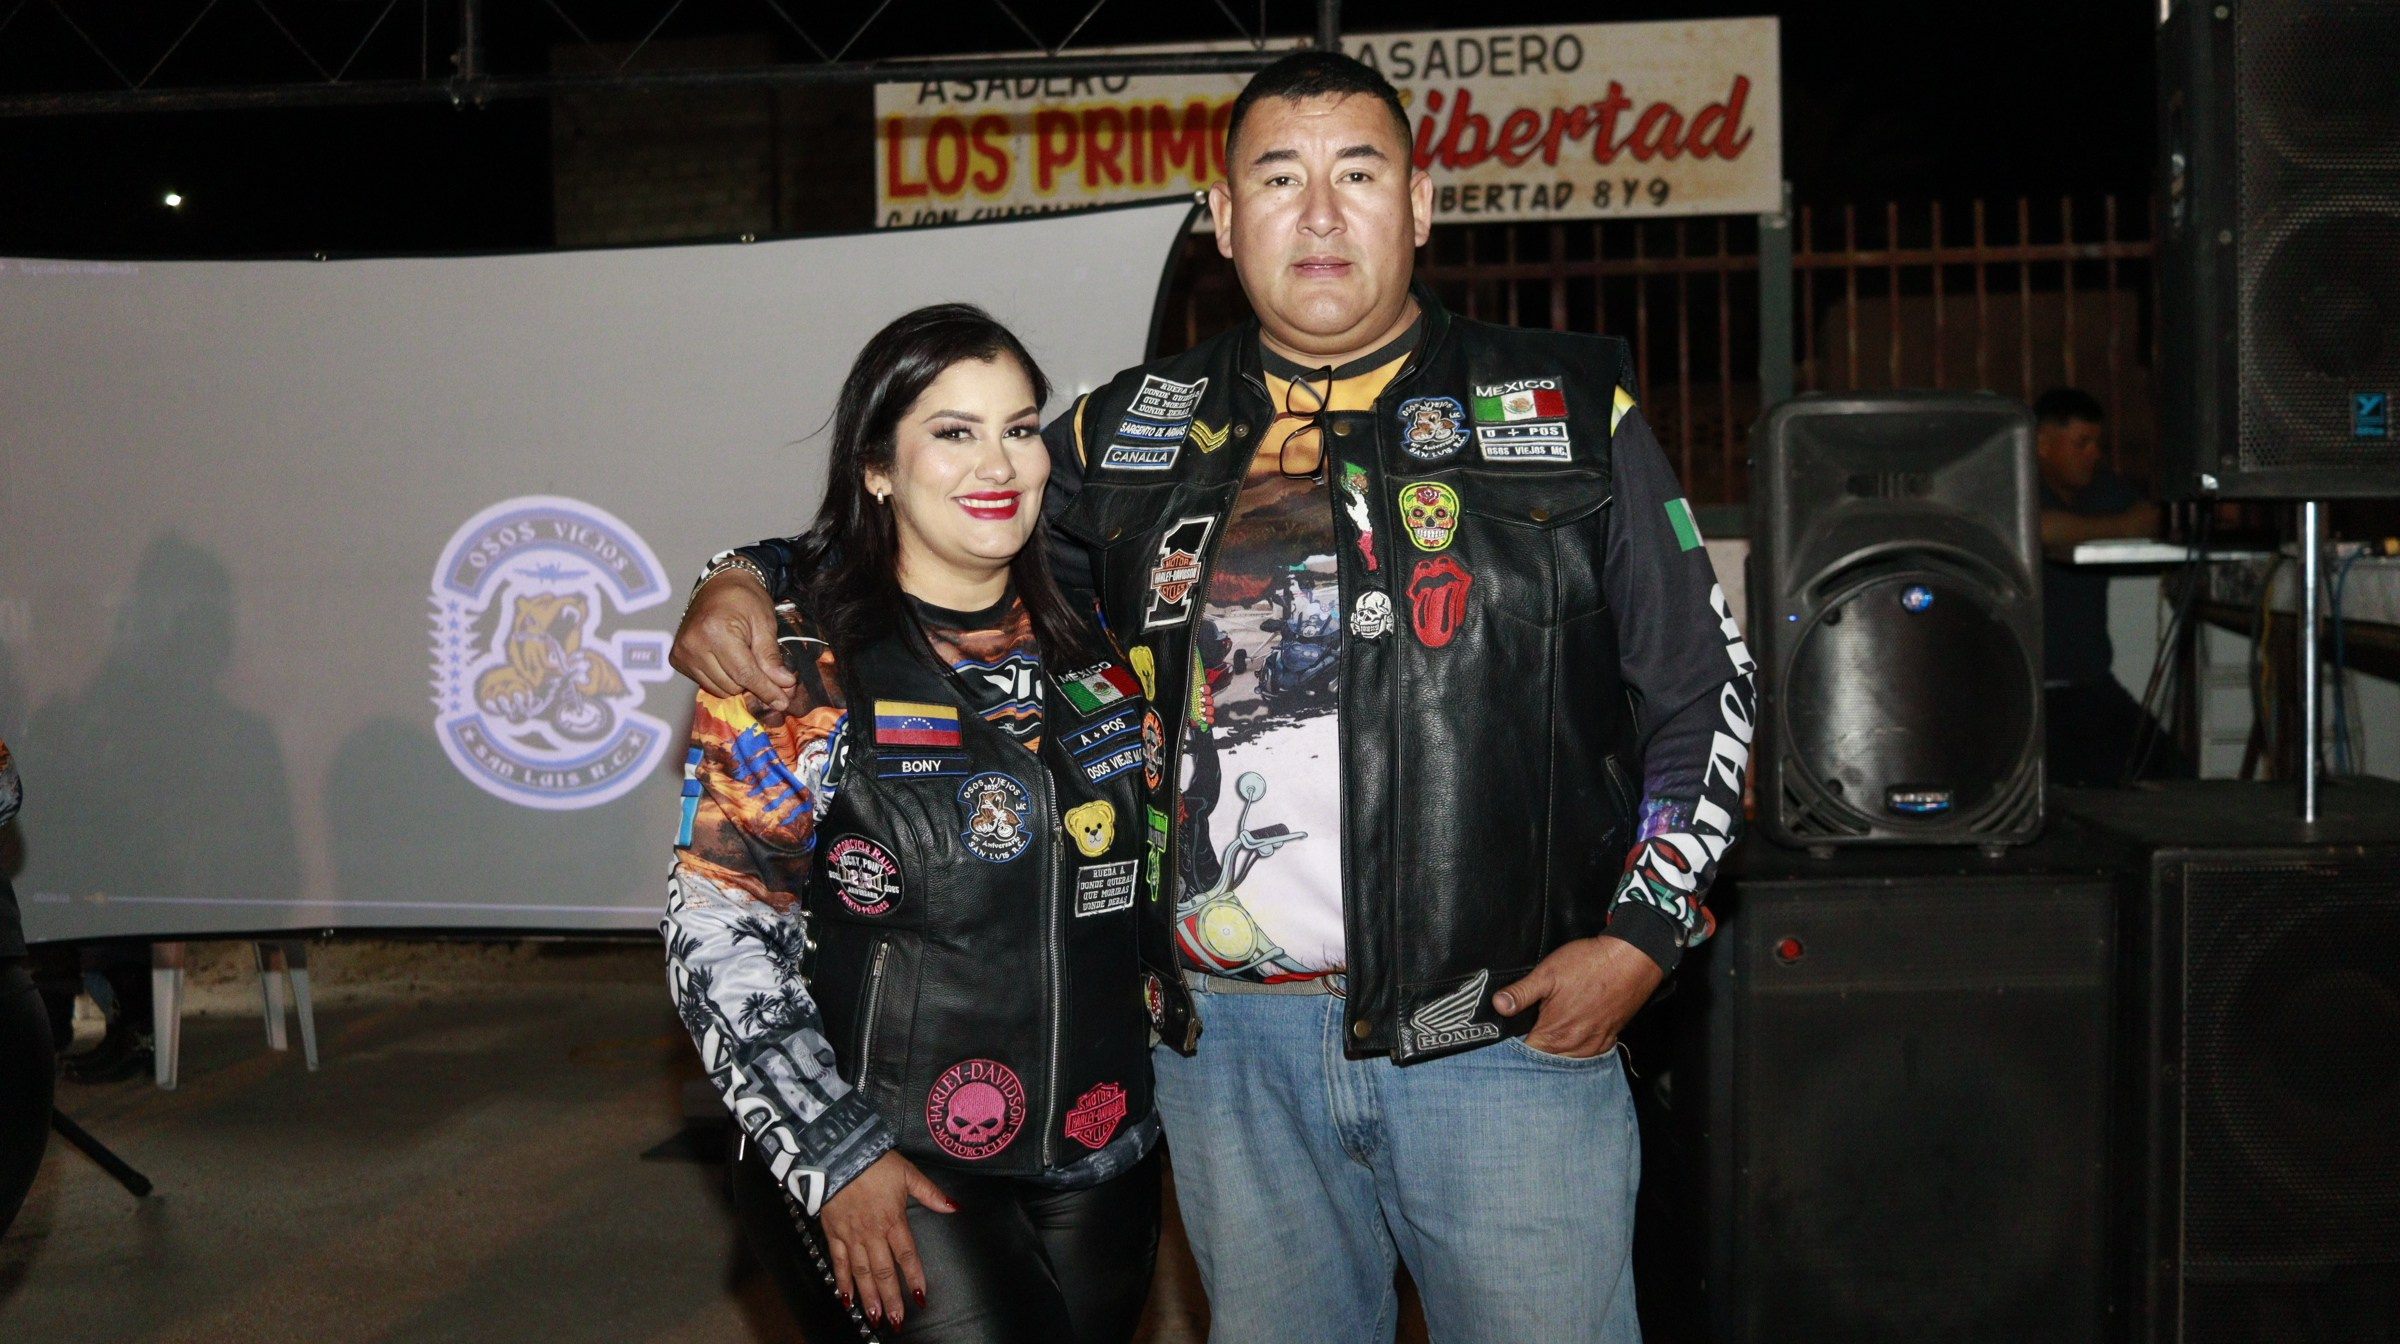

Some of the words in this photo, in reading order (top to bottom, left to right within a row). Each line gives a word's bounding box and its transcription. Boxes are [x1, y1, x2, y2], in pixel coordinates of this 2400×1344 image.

[1356, 34, 1585, 82] ASADERO
[1411, 74, 1754, 171] ibertad
[886, 113, 1012, 199] LOS
[1143, 388, 1170, 399] DONDE
[1475, 380, 1556, 398] MEXICO
[1142, 396, 1161, 406] QUE
[1138, 404, 1166, 416] DONDE
[1528, 426, 1559, 437] POS
[1112, 451, 1168, 463] CANALLA
[1486, 446, 1510, 456] OSOS
[1514, 446, 1546, 456] VIEJOS
[468, 520, 536, 569] OSOS
[1165, 557, 1190, 569] MOTOR
[1161, 584, 1186, 599] CYCLES
[1080, 734, 1092, 746] A
[1101, 717, 1126, 735] POS
[902, 760, 942, 774] BONY
[1087, 760, 1111, 779] OSOS
[963, 779, 985, 799] OSOS
[968, 841, 986, 858] SAN
[871, 847, 897, 876] RALLY
[1093, 868, 1117, 878] RUEDA
[1080, 880, 1104, 890] DONDE
[1083, 891, 1099, 900] QUE
[1083, 900, 1105, 911] DONDE
[1421, 1026, 1497, 1047] HONDA
[930, 1062, 1022, 1126] HARLEY-DAVIDSON
[935, 1127, 1011, 1157] MOTORCYCLES
